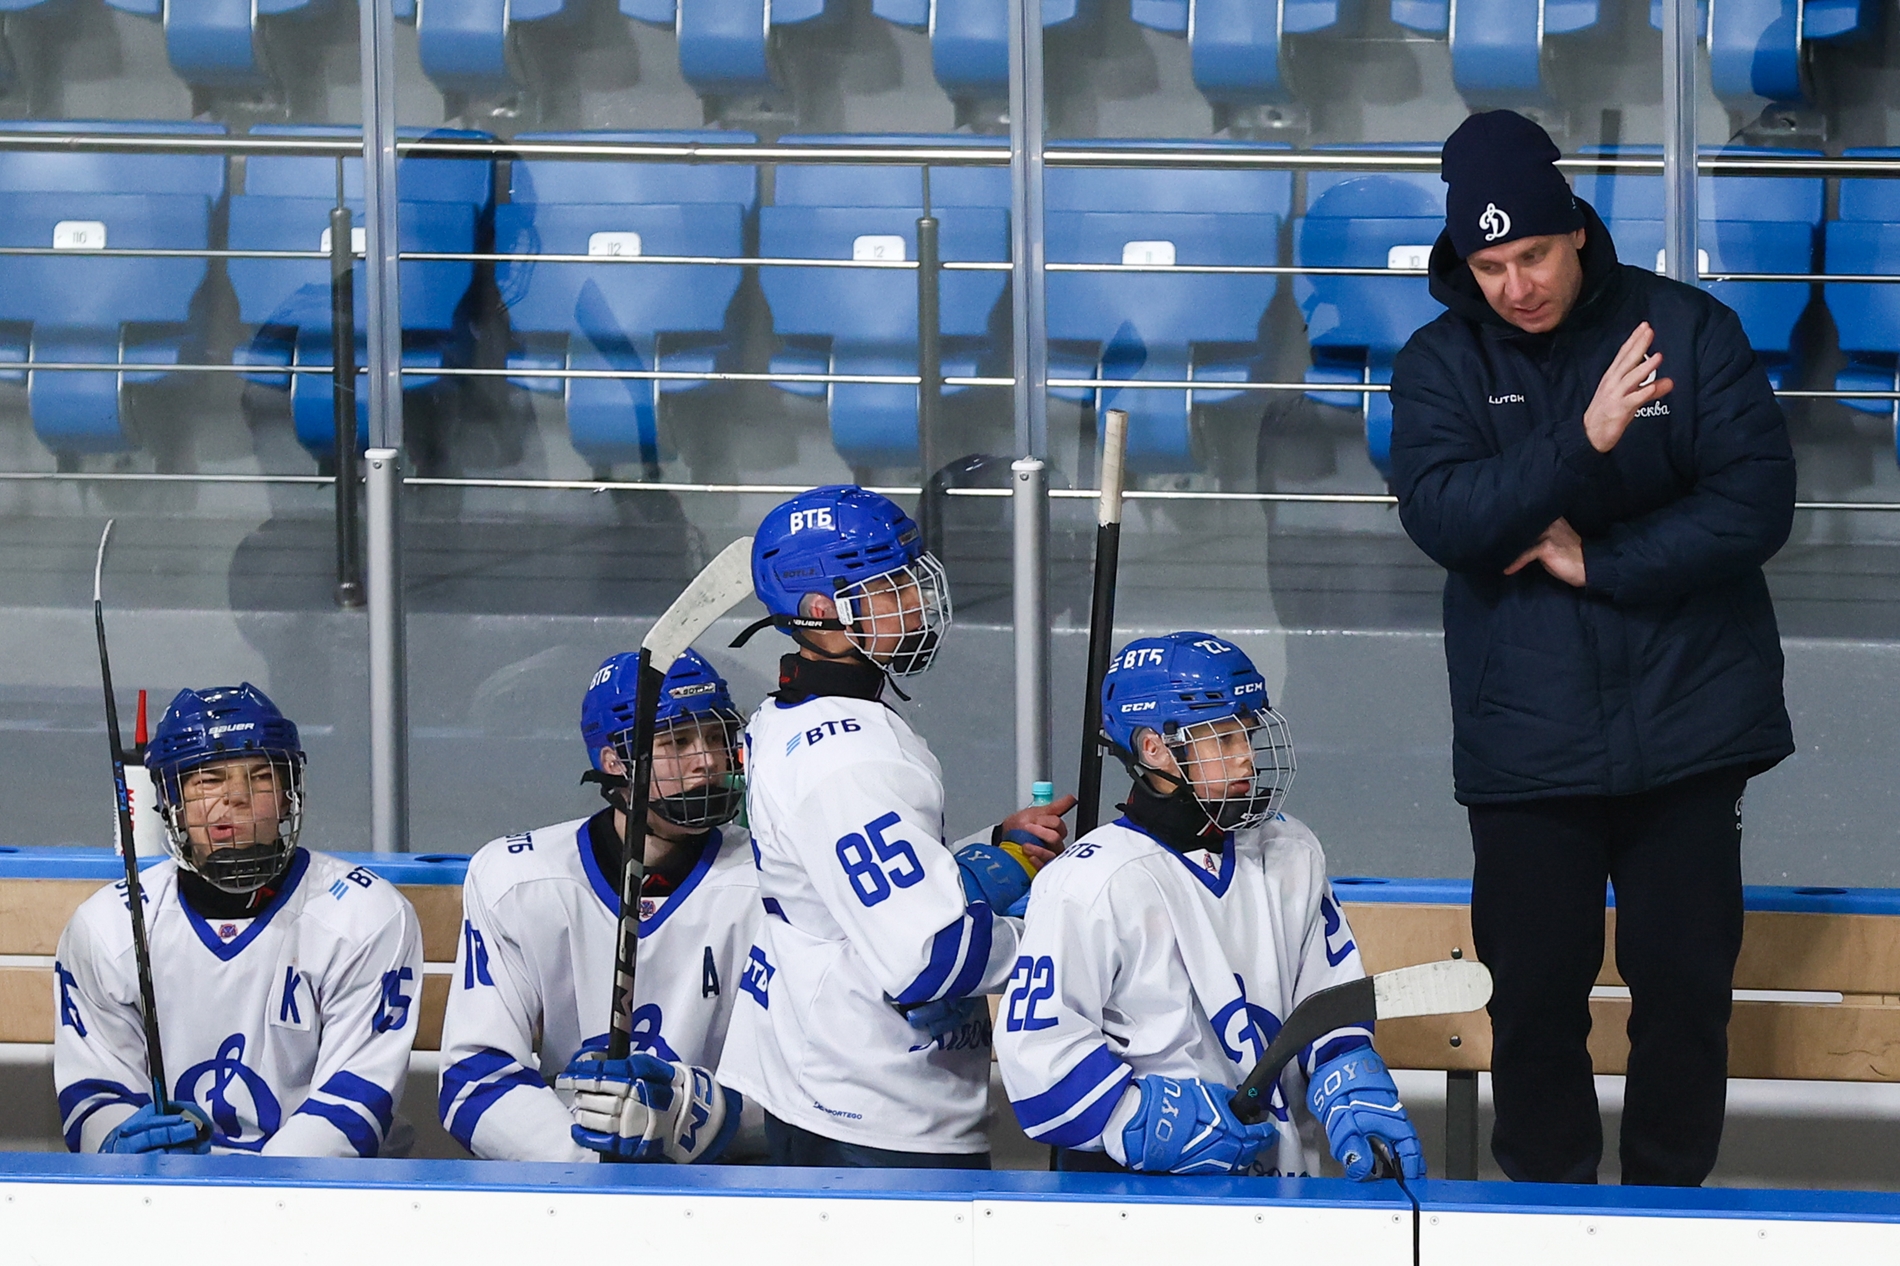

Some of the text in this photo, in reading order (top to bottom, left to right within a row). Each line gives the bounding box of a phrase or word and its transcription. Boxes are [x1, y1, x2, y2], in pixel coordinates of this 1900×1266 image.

[1488, 394, 1525, 404] LUTCH
[1634, 401, 1671, 418] осква
[789, 507, 836, 535] ВТБ
[1233, 682, 1263, 696] CCM
[1121, 701, 1157, 713] CCM
[208, 722, 255, 735] BAUER
[805, 718, 862, 747] ВТБ
[835, 810, 925, 907] 85
[1006, 955, 1059, 1032] 22
